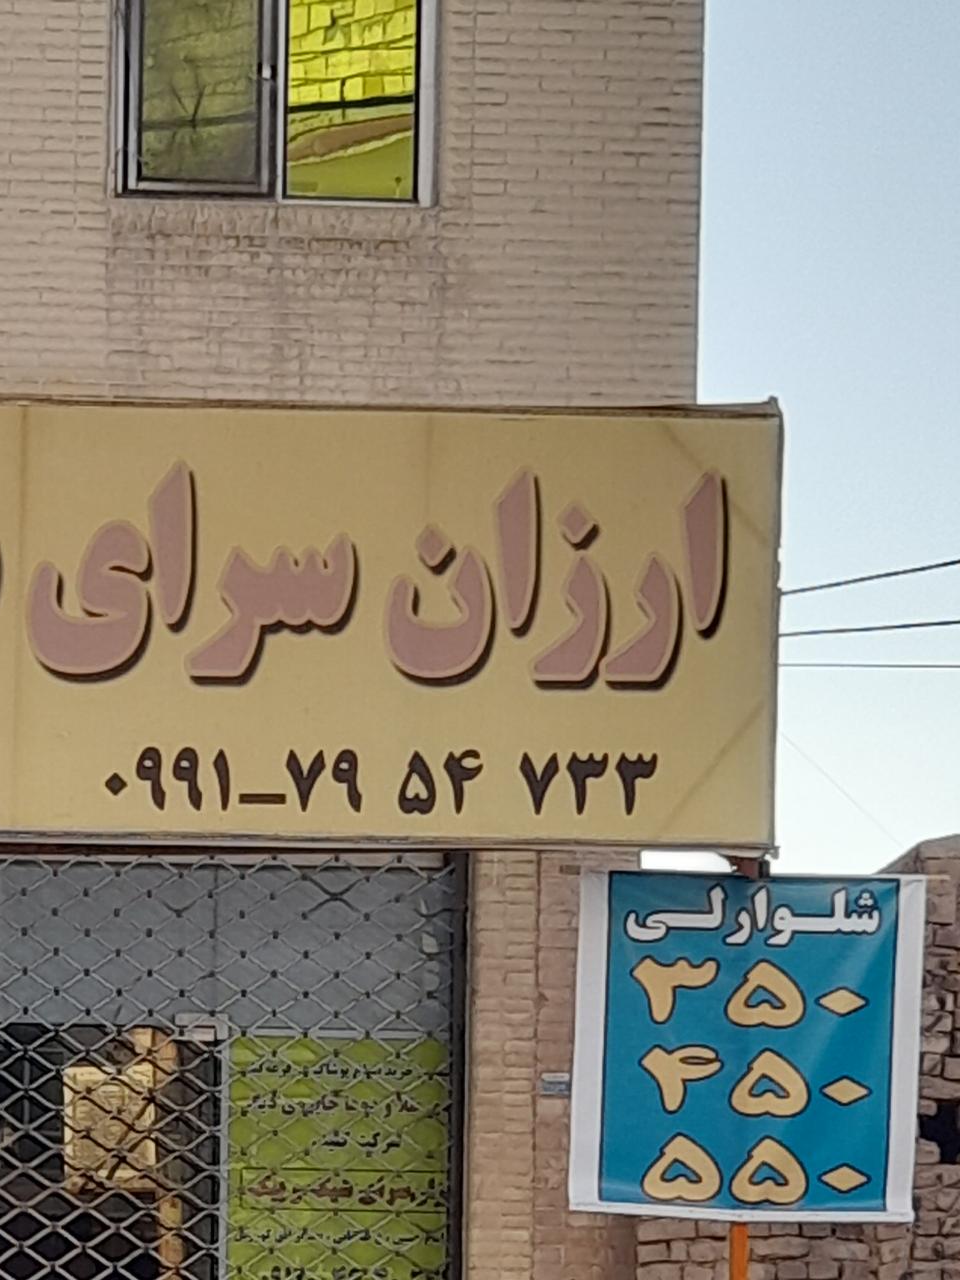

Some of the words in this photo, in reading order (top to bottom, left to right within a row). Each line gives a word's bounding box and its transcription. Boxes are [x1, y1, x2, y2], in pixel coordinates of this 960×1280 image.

[26, 459, 359, 682] سرای
[384, 467, 728, 690] ارزان
[625, 884, 727, 942] لی
[723, 886, 881, 946] شلوار
[630, 956, 869, 1029] ۳۵۰
[639, 1044, 872, 1117] ۴۵۰
[641, 1132, 871, 1206] ۵۵۰
